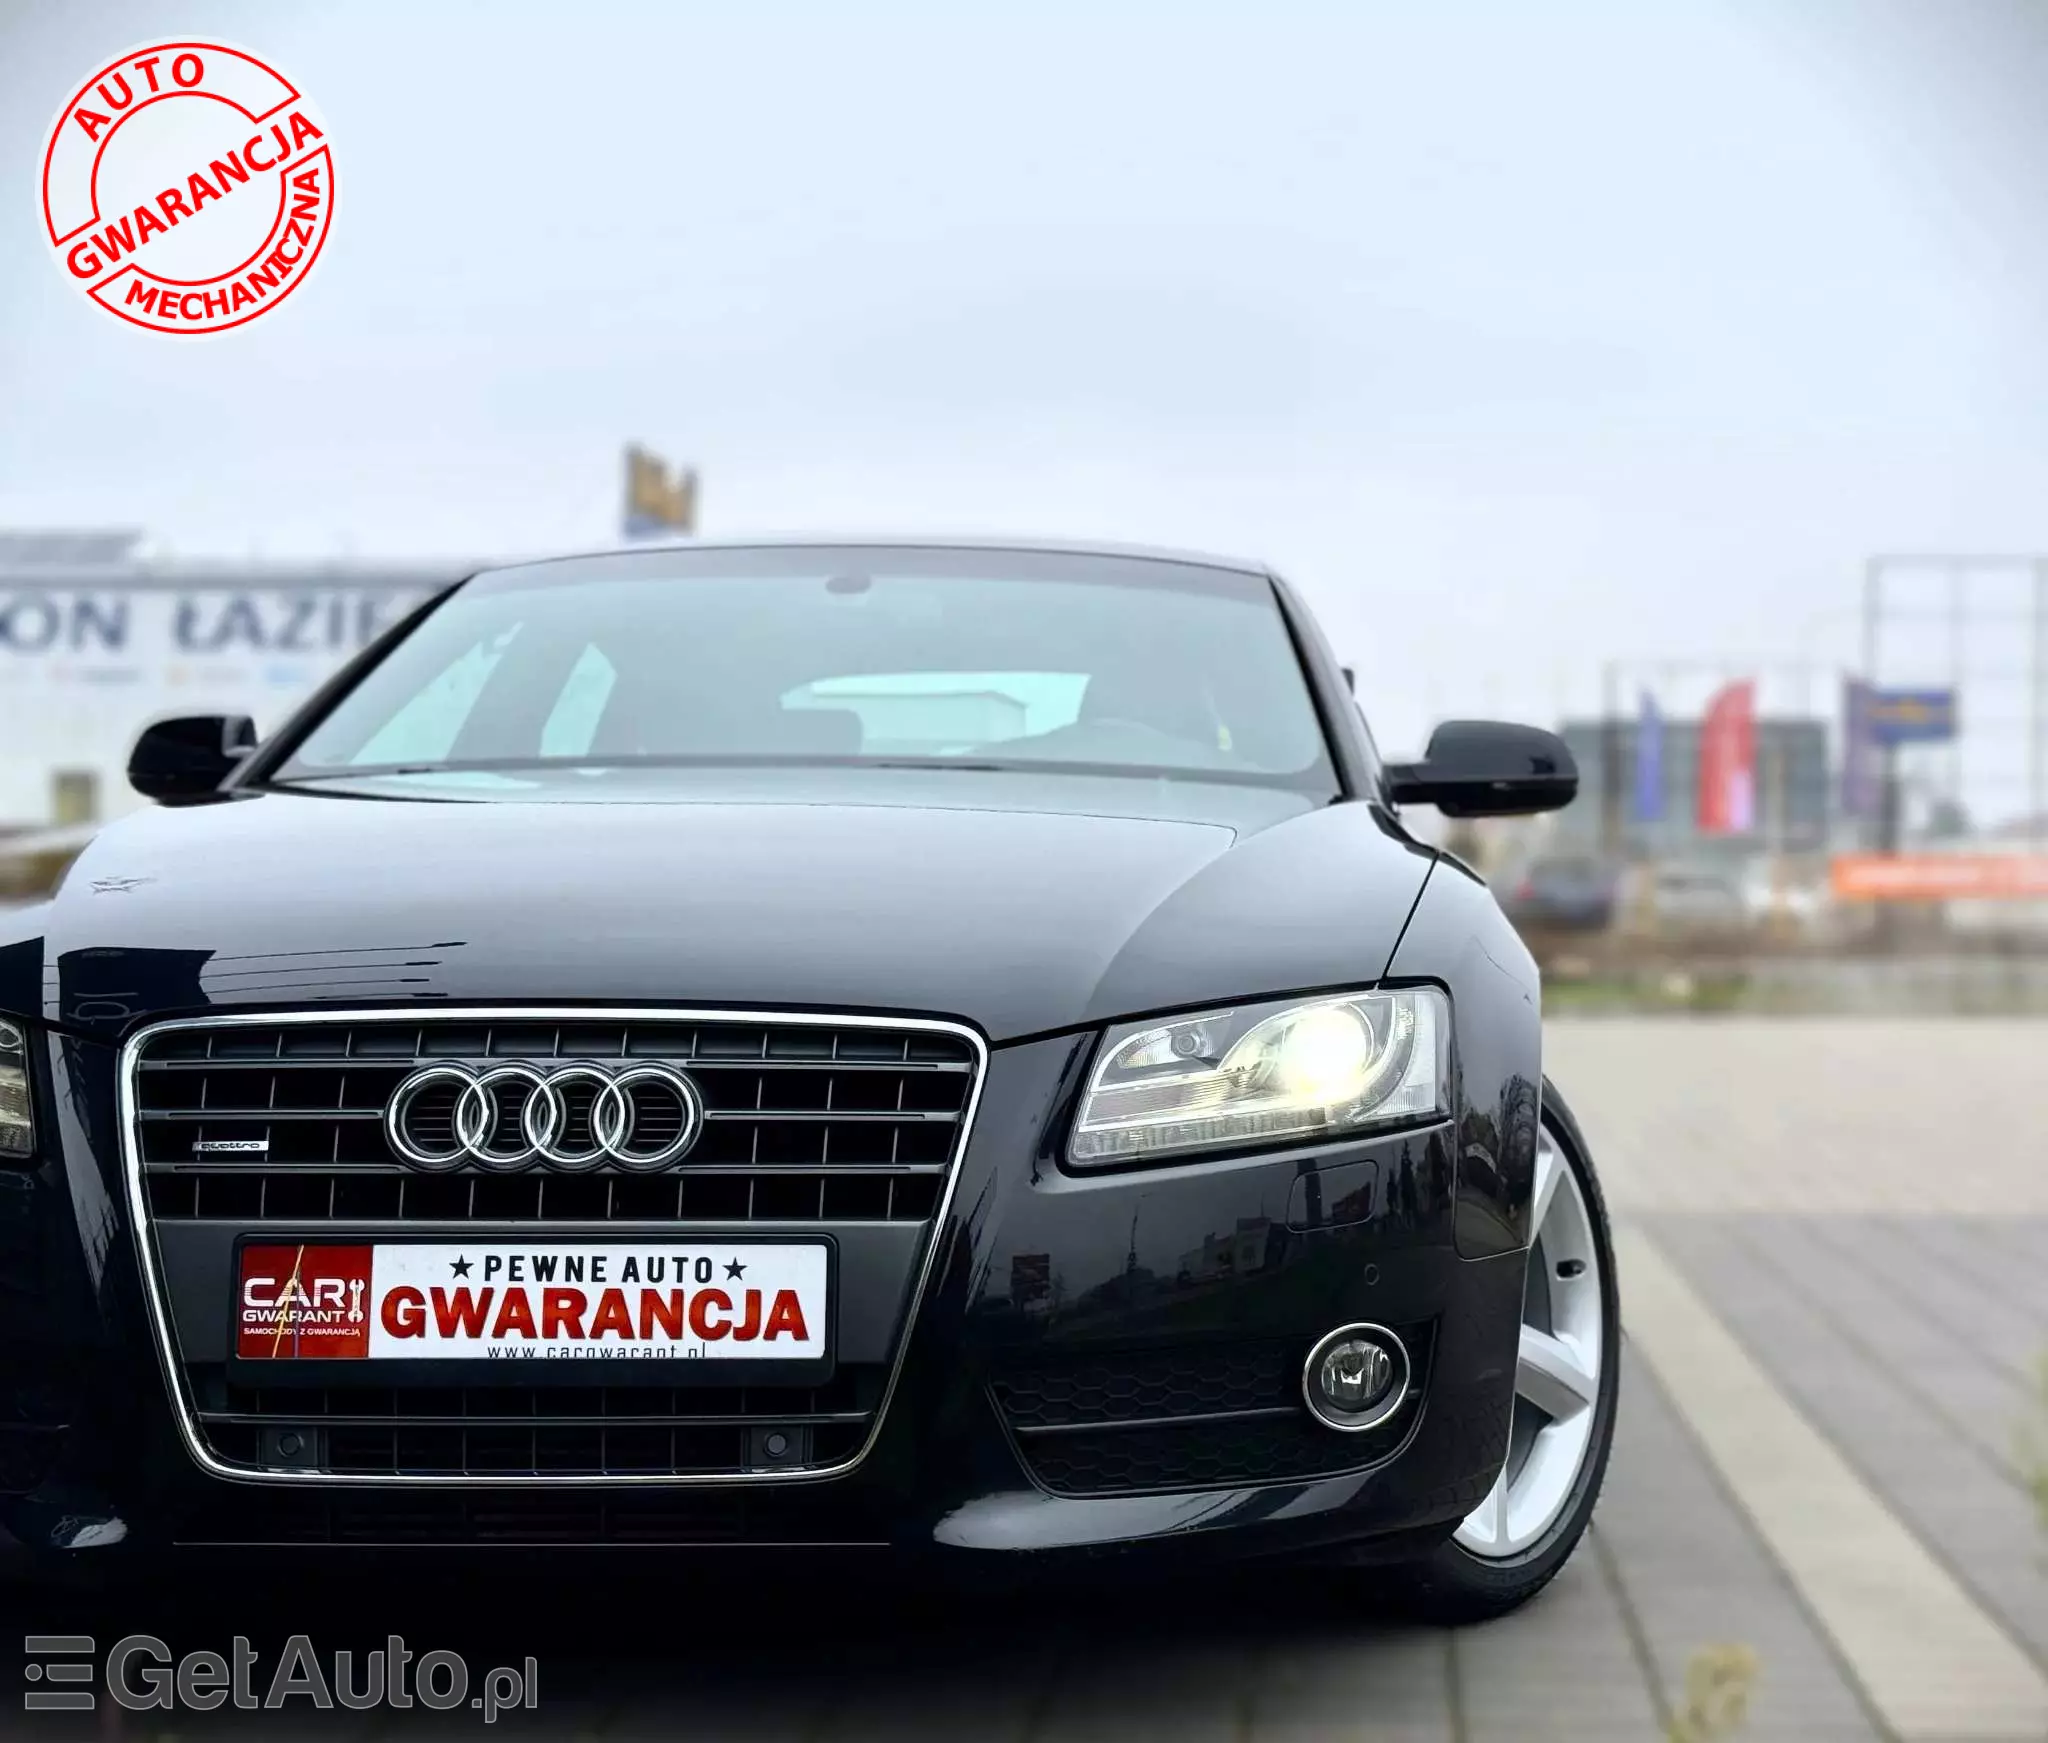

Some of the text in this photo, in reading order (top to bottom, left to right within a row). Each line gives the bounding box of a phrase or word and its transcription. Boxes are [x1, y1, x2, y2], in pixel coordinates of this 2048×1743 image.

[199, 1142, 261, 1151] quattro
[484, 1255, 713, 1284] PEWNE AUTO
[243, 1277, 346, 1307] CAR
[242, 1309, 346, 1323] GWARANT
[381, 1286, 809, 1341] GWARANCJA
